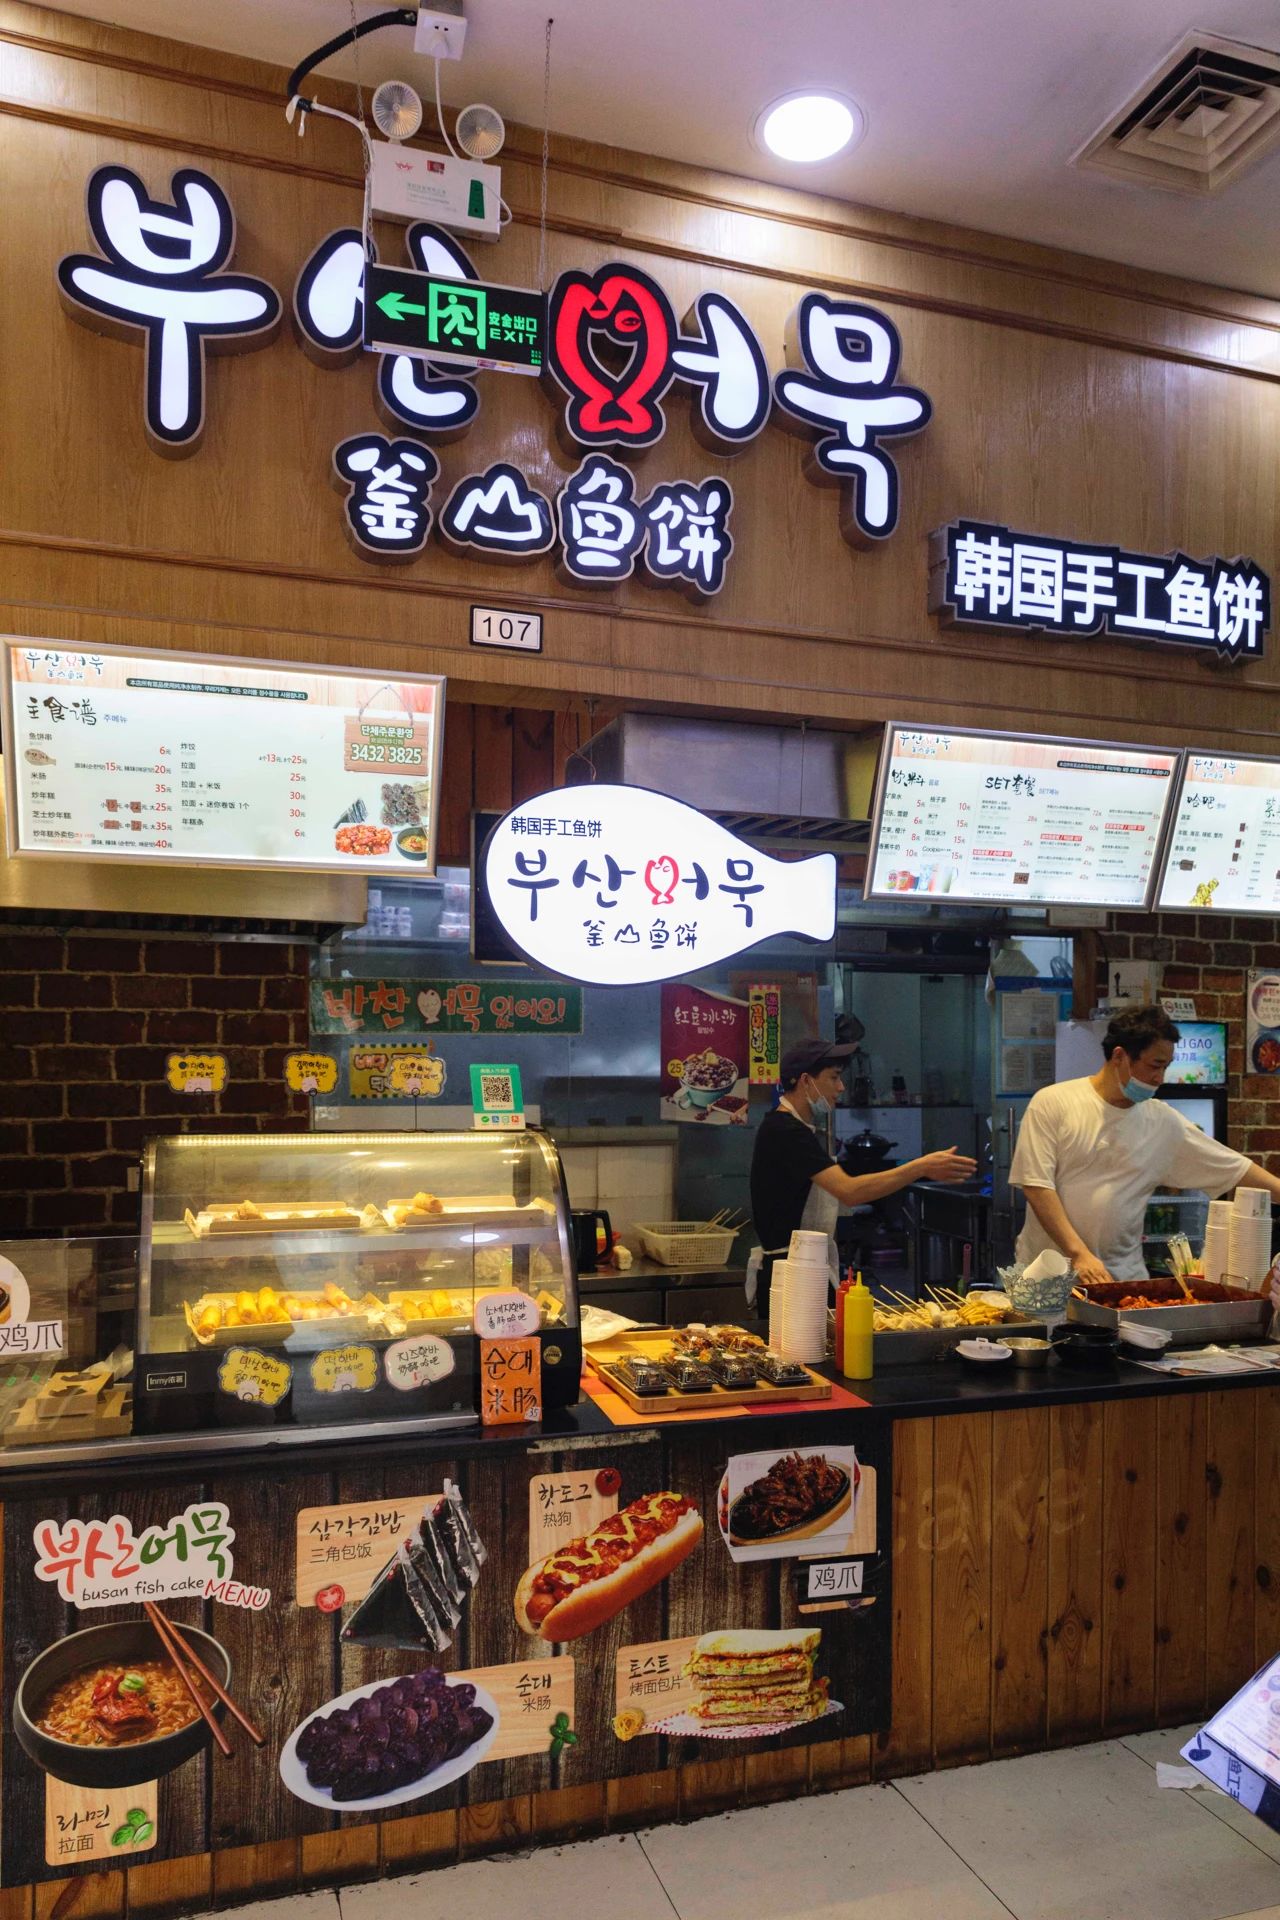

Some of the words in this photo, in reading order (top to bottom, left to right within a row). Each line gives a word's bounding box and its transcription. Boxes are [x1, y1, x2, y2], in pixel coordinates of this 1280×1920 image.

[488, 311, 538, 332] 安全出口
[489, 327, 538, 345] EXIT
[347, 447, 722, 582] 釜山鱼饼
[955, 531, 1262, 647] 韩国手工鱼饼
[481, 616, 532, 641] 107
[27, 696, 97, 726] 主食谱
[159, 745, 171, 755] 6元
[351, 744, 386, 762] 3432
[388, 746, 422, 764] 3825
[181, 762, 196, 770] 拉面
[155, 784, 172, 793] 35元
[181, 780, 197, 789] 拉面
[206, 782, 221, 790] 米饭
[290, 773, 306, 782] 25元
[181, 799, 197, 808] 拉面
[289, 791, 306, 801] 30元
[289, 808, 306, 818] 30元
[294, 829, 305, 838] 6元
[510, 816, 602, 839] 韩国手工鱼饼
[507, 849, 765, 928] 부산어묵
[583, 918, 698, 950] 釜山鱼饼
[322, 981, 410, 1030] 반찬
[674, 1006, 737, 1025] 红豆冰沙
[670, 1063, 682, 1074] 25
[0, 1322, 62, 1353] 鸡爪
[483, 1348, 533, 1380] 순대
[486, 1386, 538, 1416] 米肠
[538, 1482, 593, 1510] 핫도그
[309, 1510, 406, 1543] 삼각김밥
[542, 1511, 572, 1528] 热狗
[42, 1509, 228, 1595] 부산어묵
[310, 1543, 372, 1563] 三角包饭
[814, 1565, 858, 1592] 鸡爪
[82, 1586, 129, 1602] busan
[134, 1580, 164, 1596] fish
[170, 1577, 205, 1592] cake
[204, 1579, 271, 1609] MENU
[628, 1654, 671, 1680] 토스트
[514, 1673, 552, 1699] 순대
[629, 1675, 684, 1697] 烤面包片
[522, 1697, 551, 1713] 米肠
[56, 1804, 112, 1831] 라면
[58, 1833, 94, 1855] 拉面
